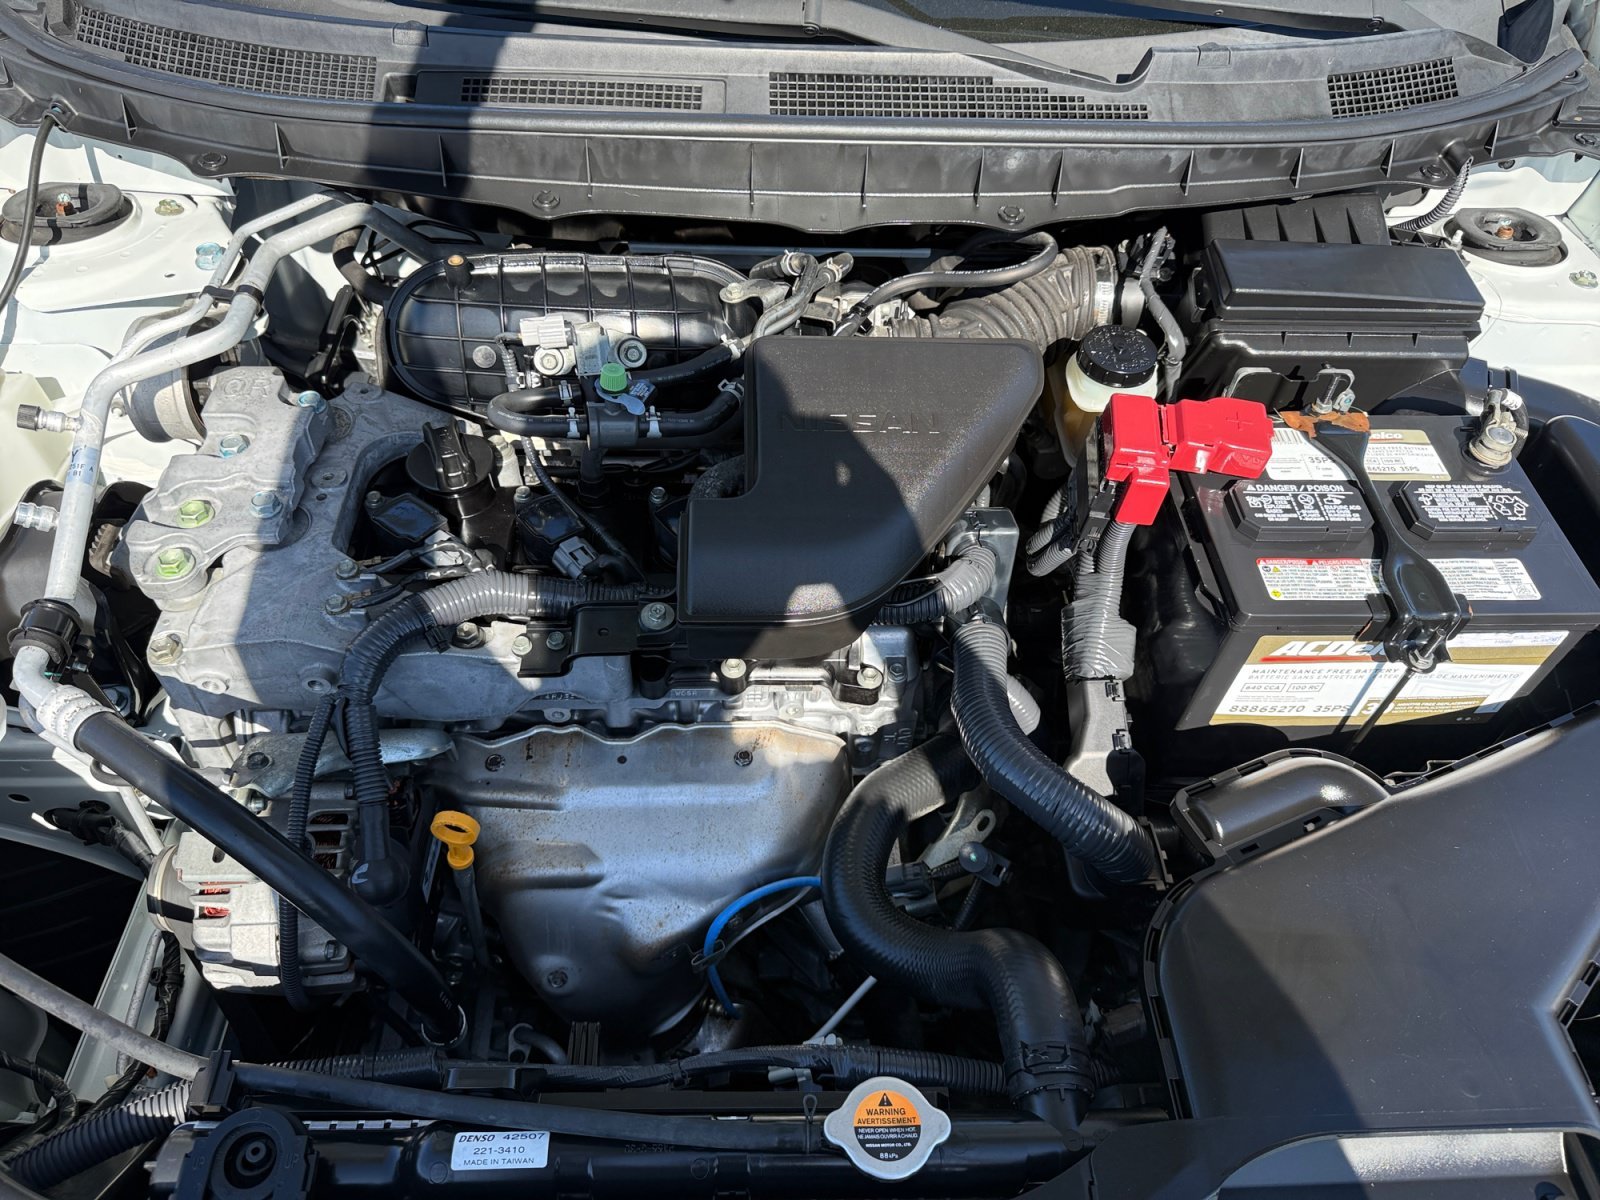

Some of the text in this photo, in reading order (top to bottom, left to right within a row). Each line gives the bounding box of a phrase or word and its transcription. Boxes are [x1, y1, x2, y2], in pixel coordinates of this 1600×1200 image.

[780, 411, 941, 434] NISSAN
[1269, 641, 1385, 656] ACDel
[1229, 704, 1352, 713] 88865270 35PS
[866, 1108, 906, 1116] WARNING
[857, 1117, 916, 1125] AVERTISSEMENT
[459, 1133, 546, 1142] DENSO 42507
[473, 1146, 525, 1155] 221-3410
